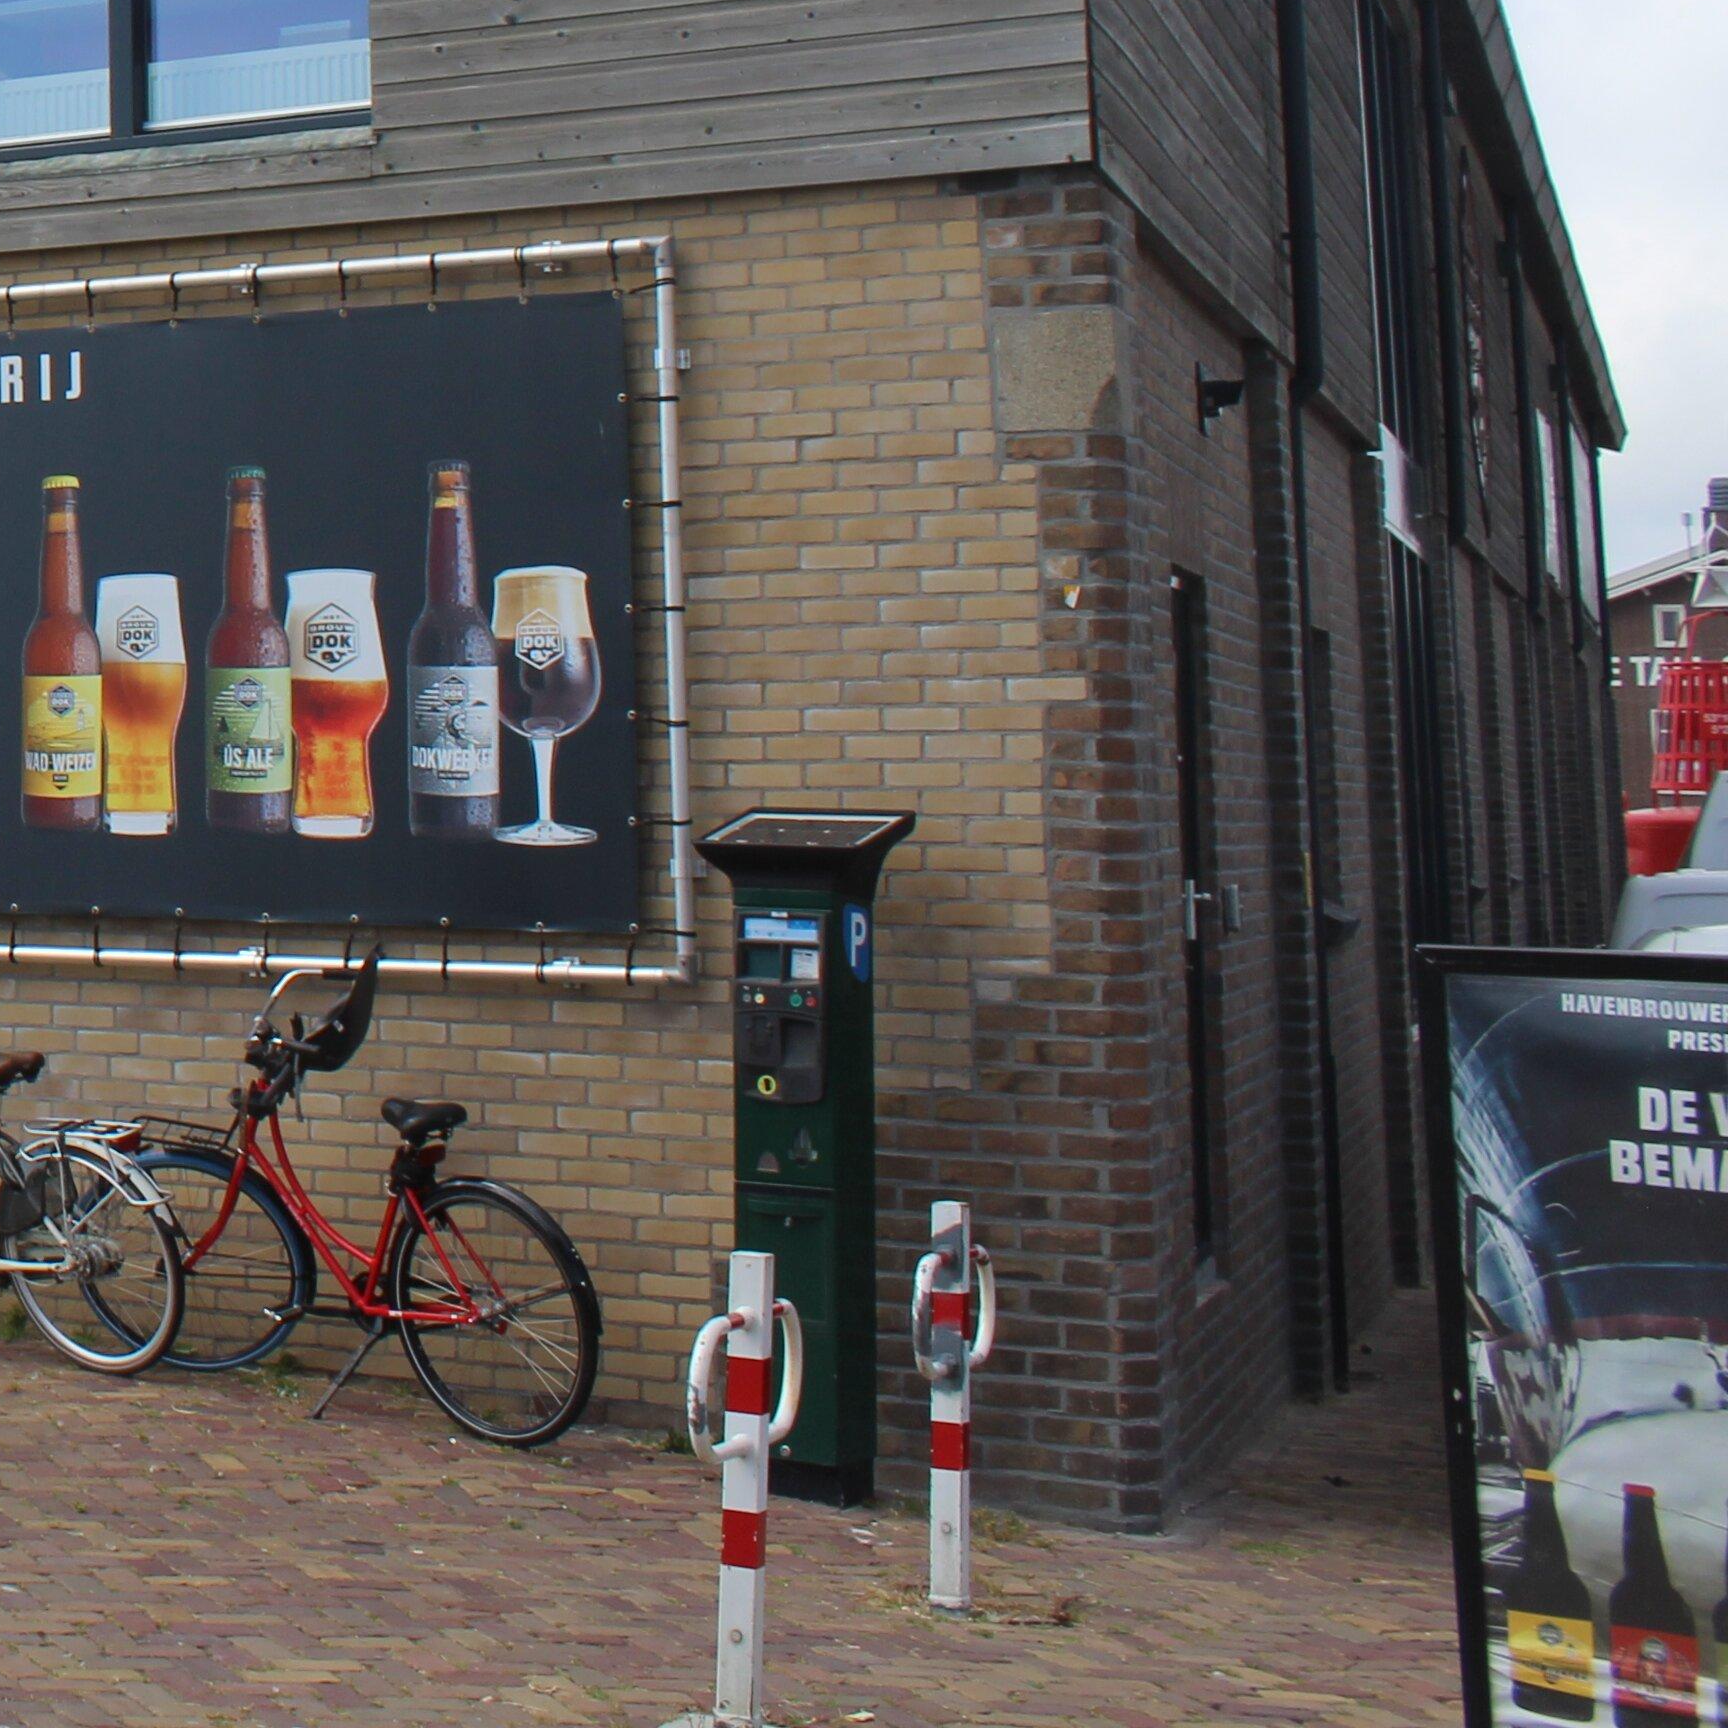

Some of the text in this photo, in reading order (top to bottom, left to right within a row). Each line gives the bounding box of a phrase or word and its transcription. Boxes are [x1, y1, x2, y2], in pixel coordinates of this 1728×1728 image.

[123, 631, 152, 641] DOK
[312, 635, 352, 648] DOK
[523, 635, 557, 648] DOK
[245, 745, 274, 768] ALE
[851, 912, 866, 968] P
[1638, 1087, 1699, 1134] DE
